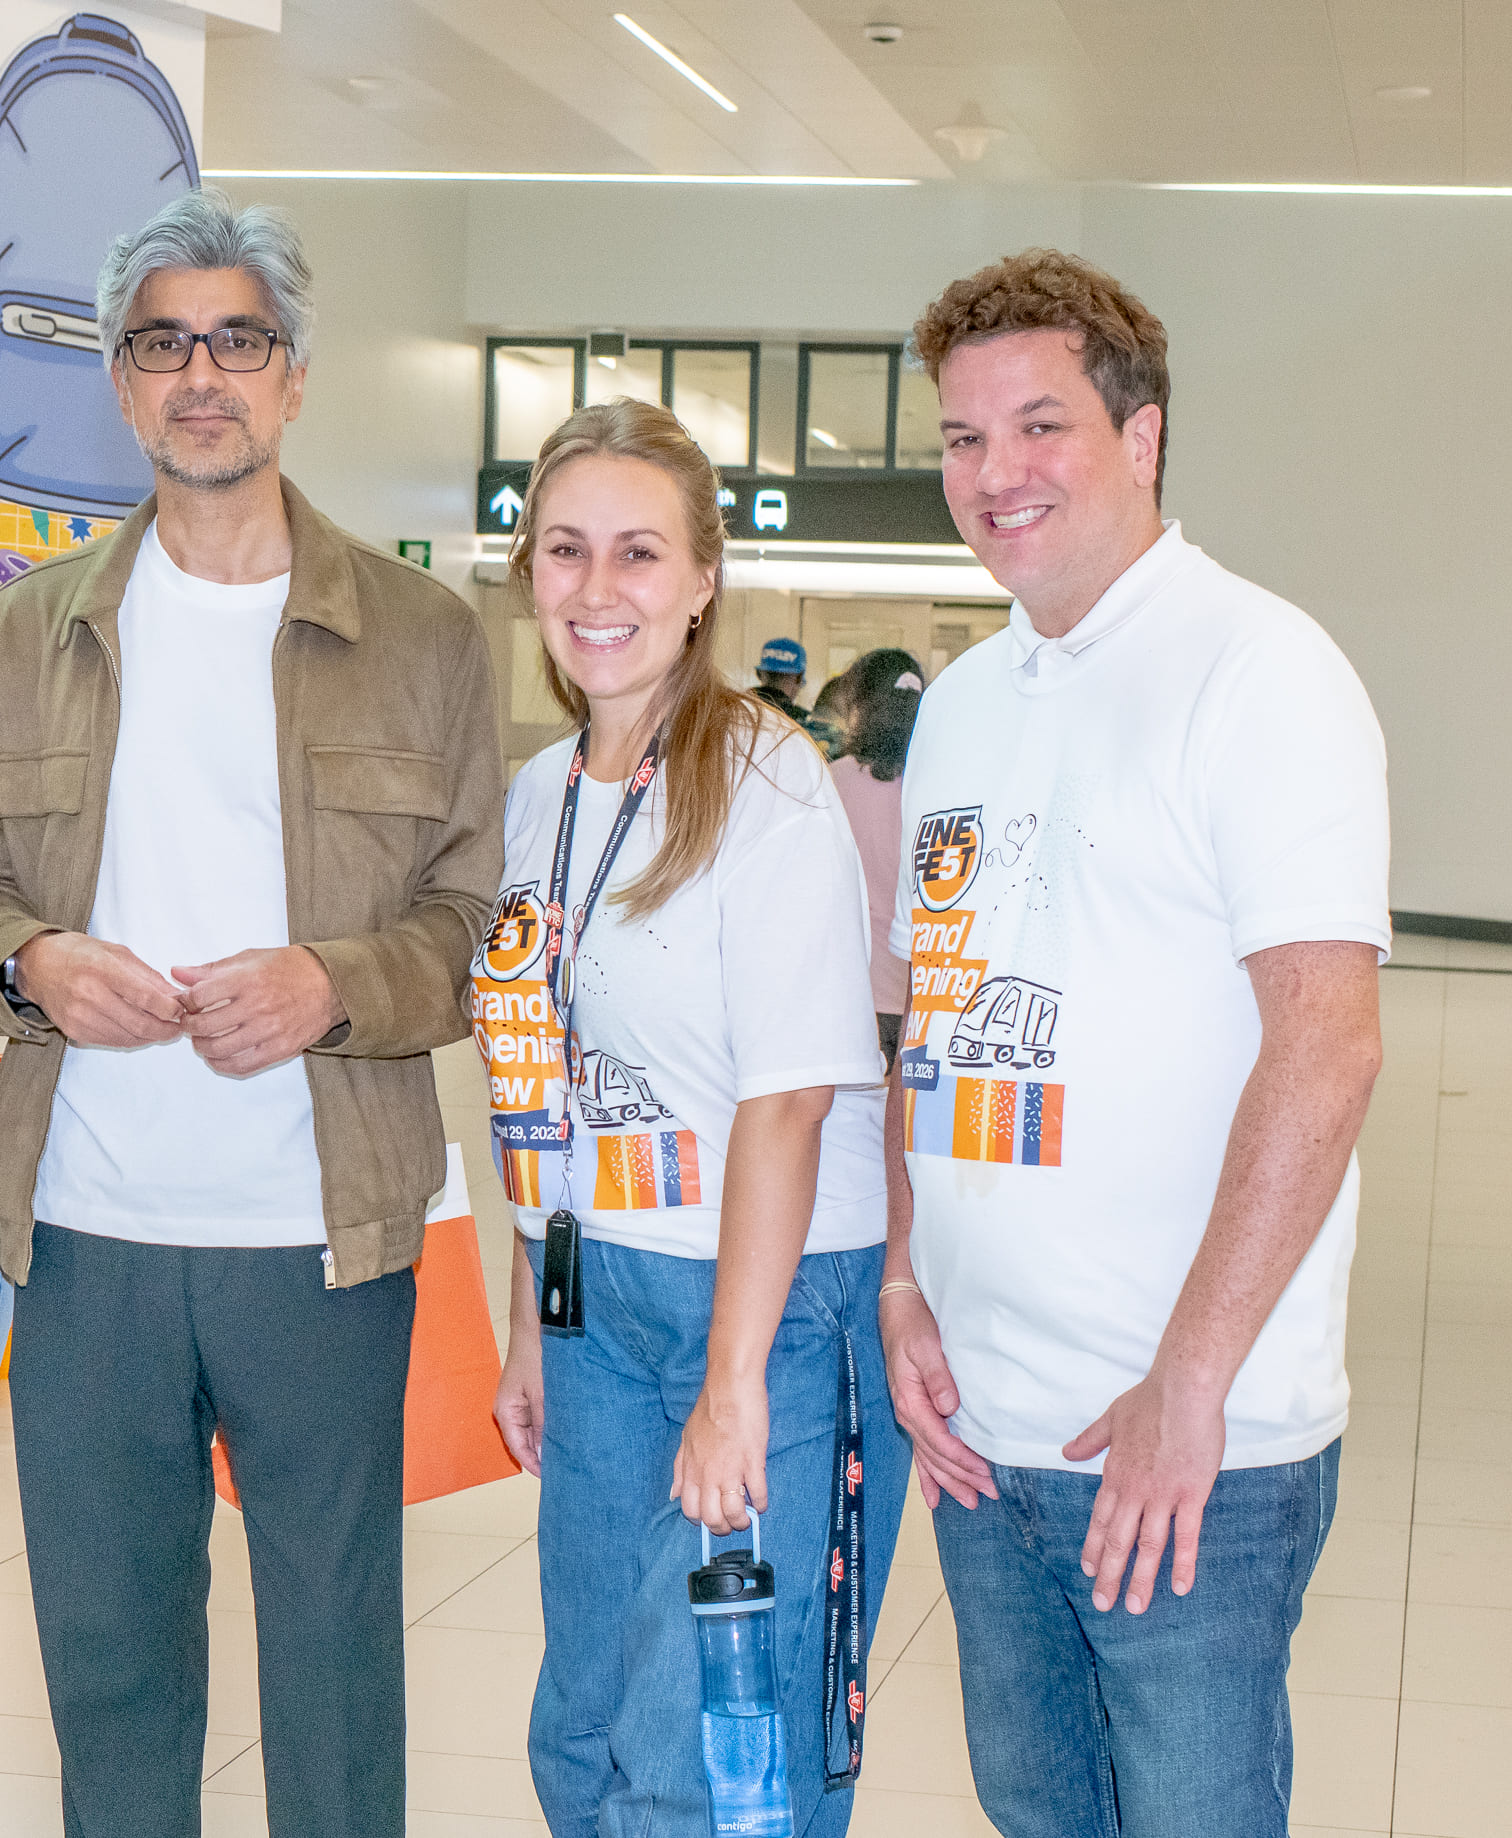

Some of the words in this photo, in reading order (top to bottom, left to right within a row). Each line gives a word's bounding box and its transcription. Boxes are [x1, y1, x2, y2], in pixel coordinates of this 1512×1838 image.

[555, 805, 573, 880] Communications
[592, 814, 629, 892] Communications
[915, 814, 977, 852] LINE
[912, 916, 969, 953] rand
[912, 958, 981, 1008] ening
[914, 1062, 935, 1080] 2026
[509, 1125, 527, 1142] 29,
[848, 1384, 858, 1435] EXPERIENCE
[850, 1510, 858, 1560] MARKETING
[850, 1568, 859, 1613] CUSTOMER
[829, 1608, 839, 1657] MARKETING
[850, 1614, 859, 1665] EXPERIENCE
[825, 1664, 834, 1711] CUSTOMER
[717, 1821, 753, 1833] contigo
